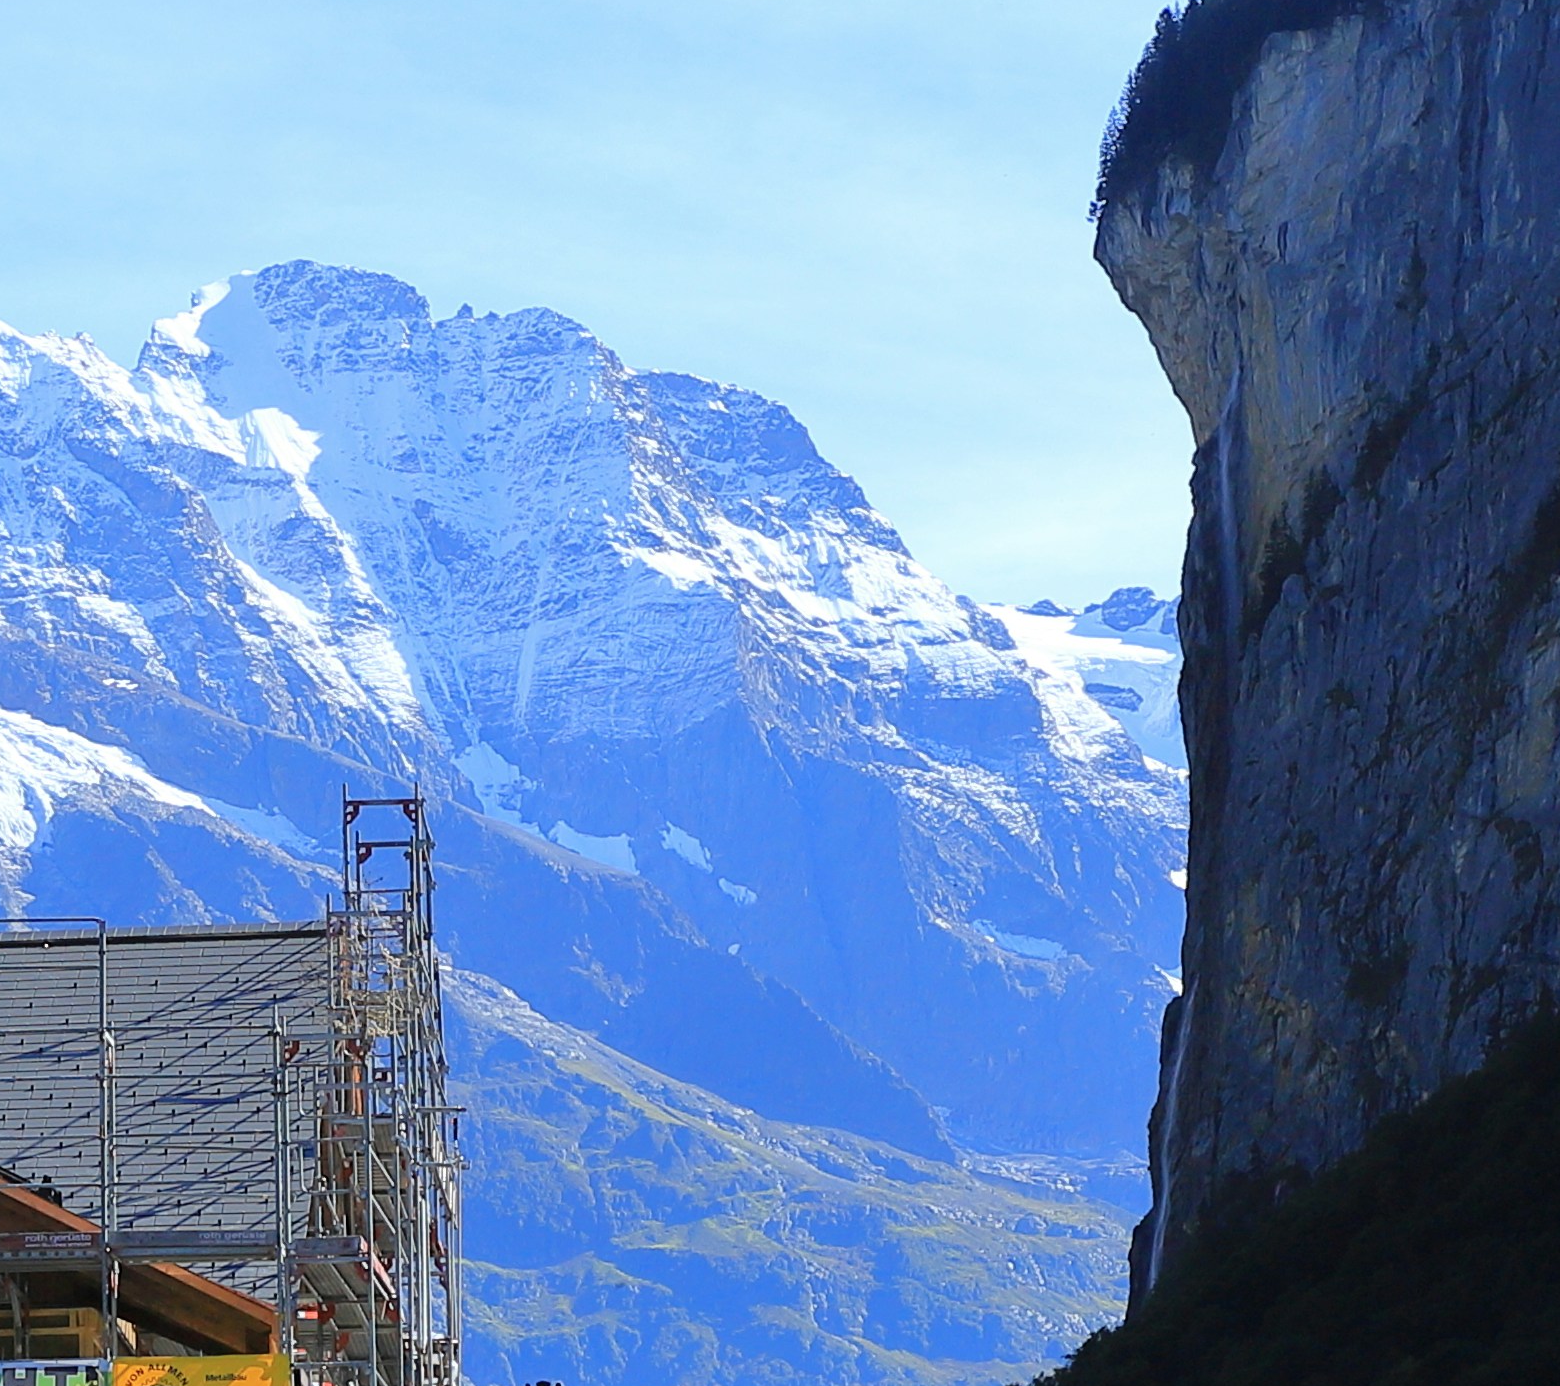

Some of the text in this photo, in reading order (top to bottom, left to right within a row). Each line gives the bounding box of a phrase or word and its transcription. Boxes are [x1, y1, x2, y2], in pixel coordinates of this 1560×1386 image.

[25, 1234, 47, 1242] roth
[125, 1363, 190, 1386] VON ALLMEN
